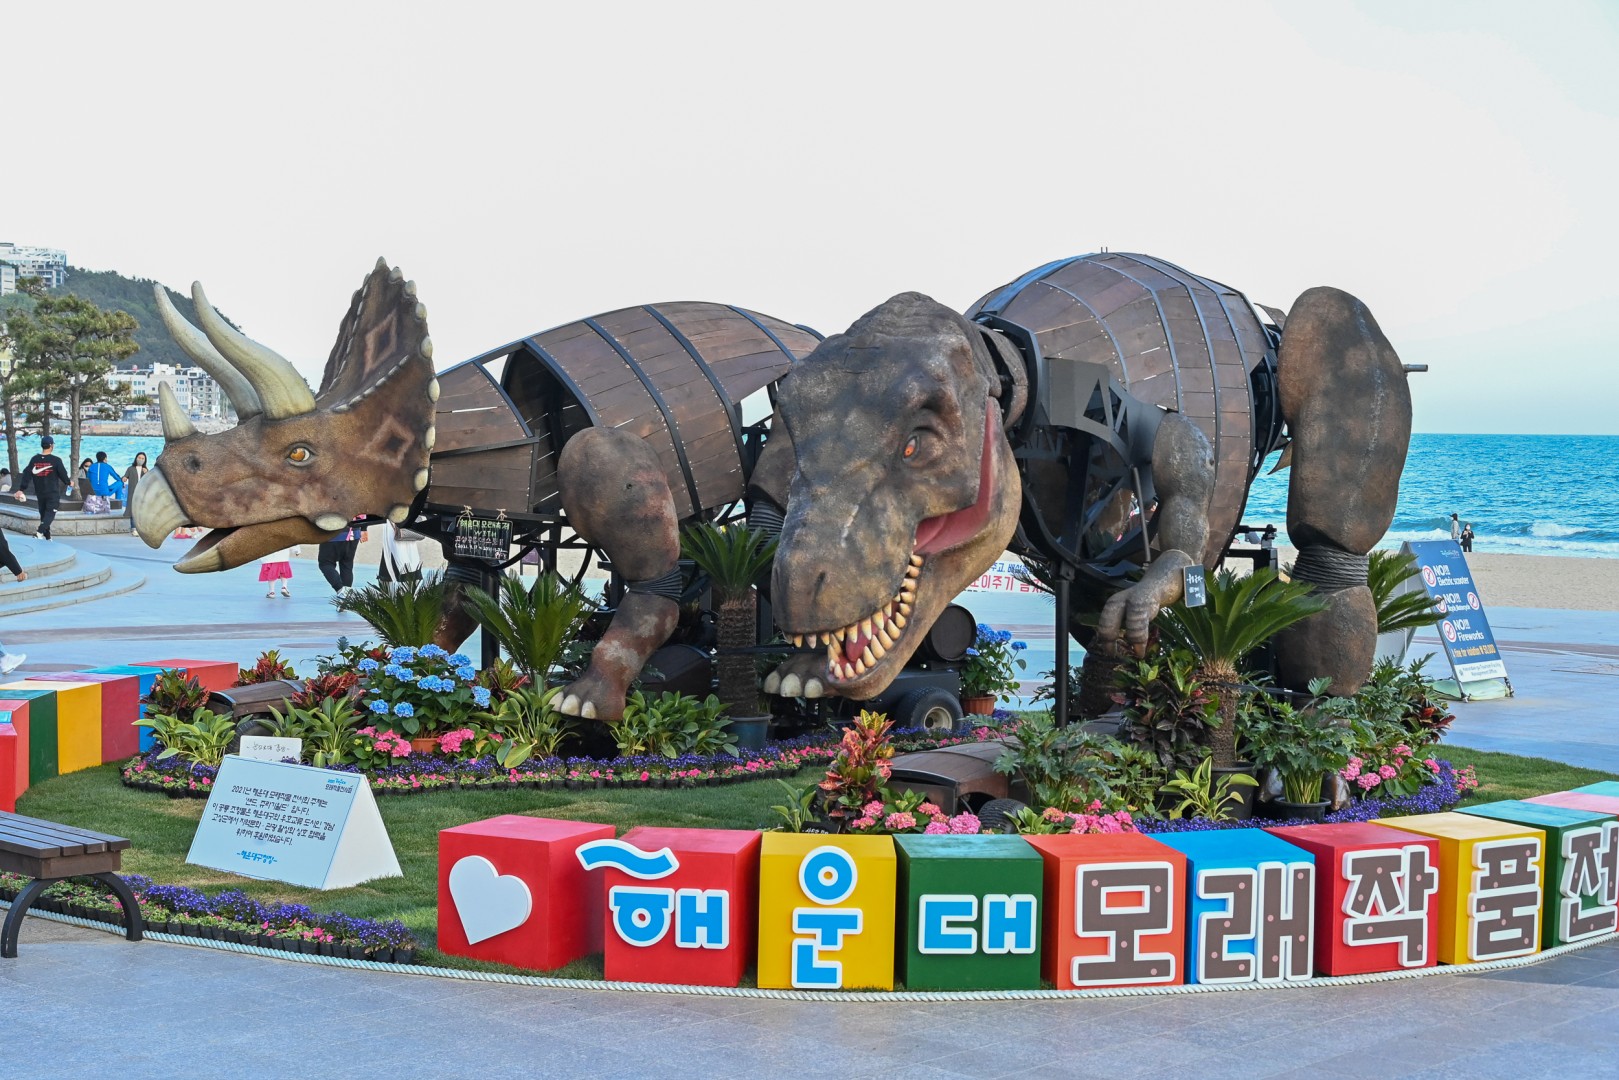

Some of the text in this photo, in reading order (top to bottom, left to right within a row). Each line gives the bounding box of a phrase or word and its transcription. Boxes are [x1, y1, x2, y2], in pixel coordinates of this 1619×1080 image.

[1437, 576, 1454, 586] Electric
[1457, 630, 1484, 642] Fireworks
[232, 785, 328, 808] 2021년 해운대 모래작품 전시회 주제는
[212, 813, 239, 825] 고성군에서
[278, 824, 296, 835] 활성화
[296, 828, 309, 837] 상호
[309, 830, 327, 841] 협력을
[219, 803, 229, 813] 공룡
[230, 806, 252, 817] 조형물은
[253, 809, 280, 821] 해운대구의
[280, 814, 303, 825] 우호교류
[304, 818, 322, 829] 도시인
[235, 828, 253, 838] 위하여
[575, 838, 1037, 990] 해운대
